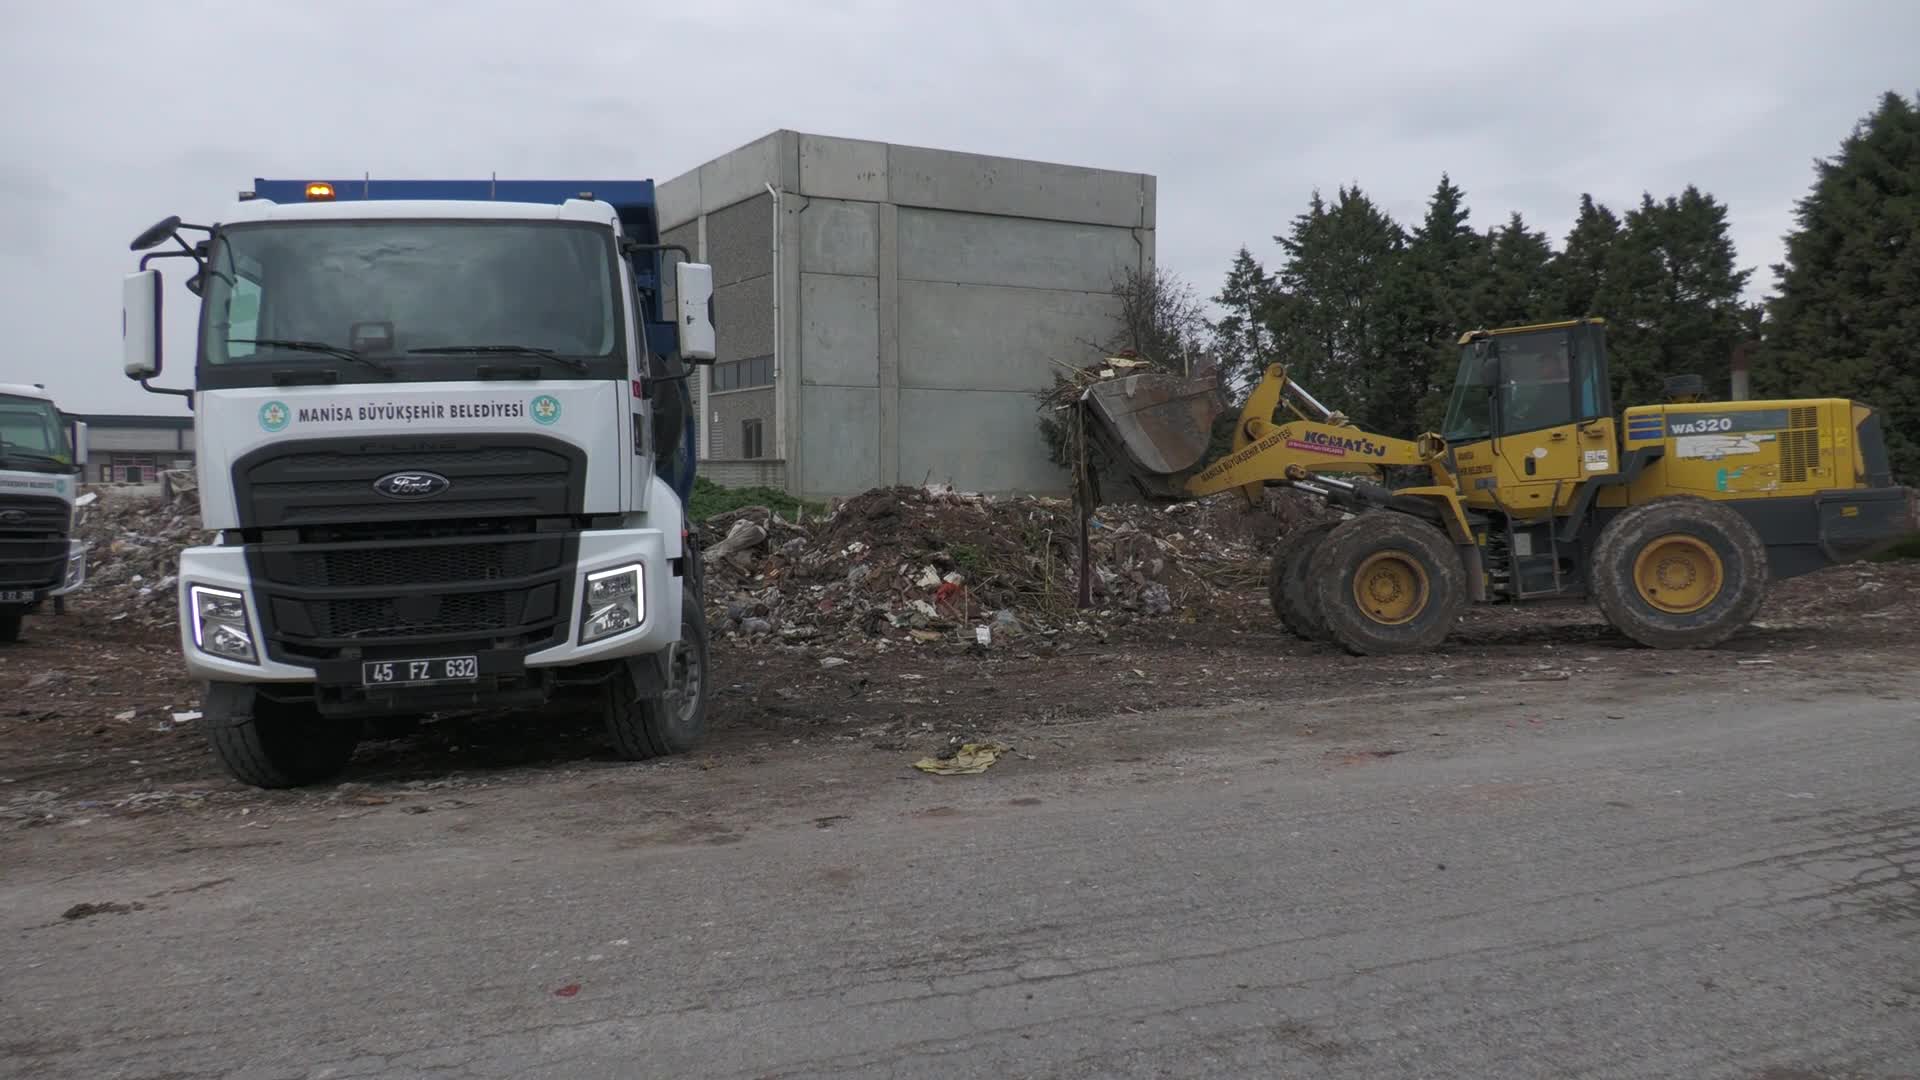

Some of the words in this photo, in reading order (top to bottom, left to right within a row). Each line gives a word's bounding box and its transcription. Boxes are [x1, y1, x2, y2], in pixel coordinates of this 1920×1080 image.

[299, 404, 353, 422] MANİSA
[359, 402, 445, 423] BÜYÜKŞEHİR
[450, 400, 524, 419] BELEDİYESİ
[1671, 418, 1732, 434] WA320
[391, 476, 431, 493] Ford
[373, 663, 393, 681] 45
[409, 661, 430, 679] FZ
[446, 659, 475, 677] 632
